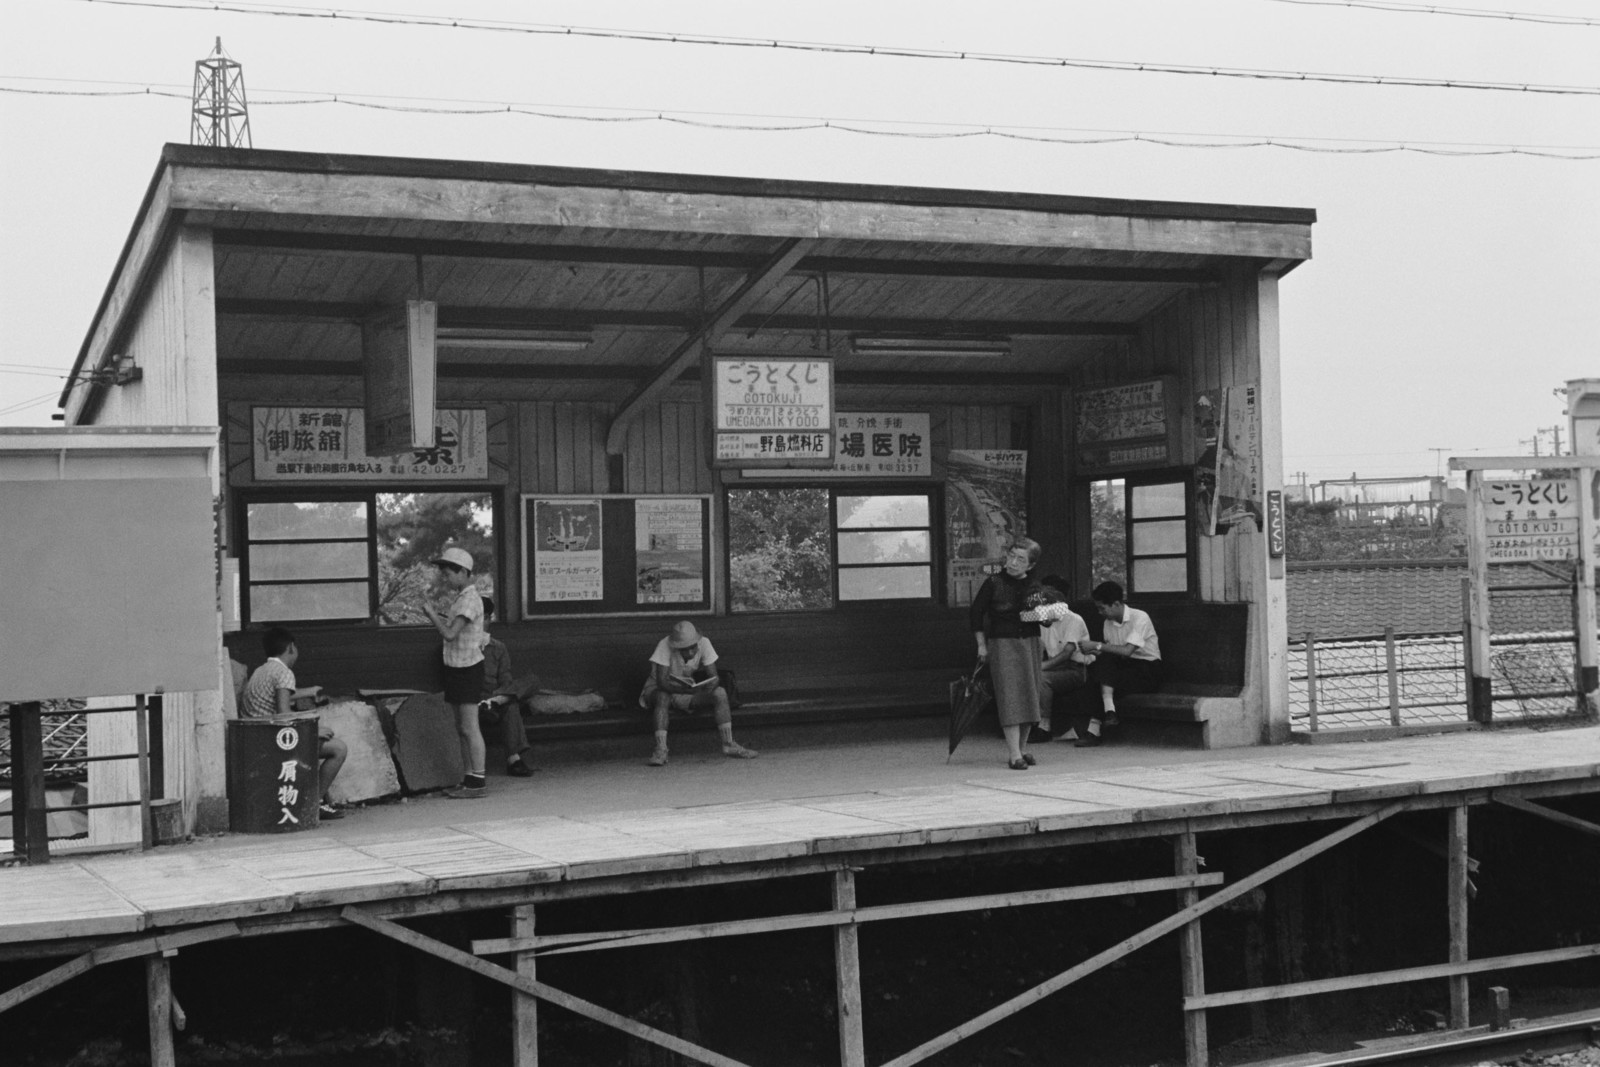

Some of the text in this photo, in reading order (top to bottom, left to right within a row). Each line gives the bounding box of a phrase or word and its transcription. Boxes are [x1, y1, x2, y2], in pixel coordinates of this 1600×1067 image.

[728, 361, 819, 384] ごうとくじ
[726, 416, 773, 427] UMEGAOKA
[760, 434, 824, 452] 野島燃料店
[1492, 482, 1569, 505] ごうとくじ
[1270, 492, 1283, 552] ごうとくじ
[277, 760, 299, 825] 屑物入
